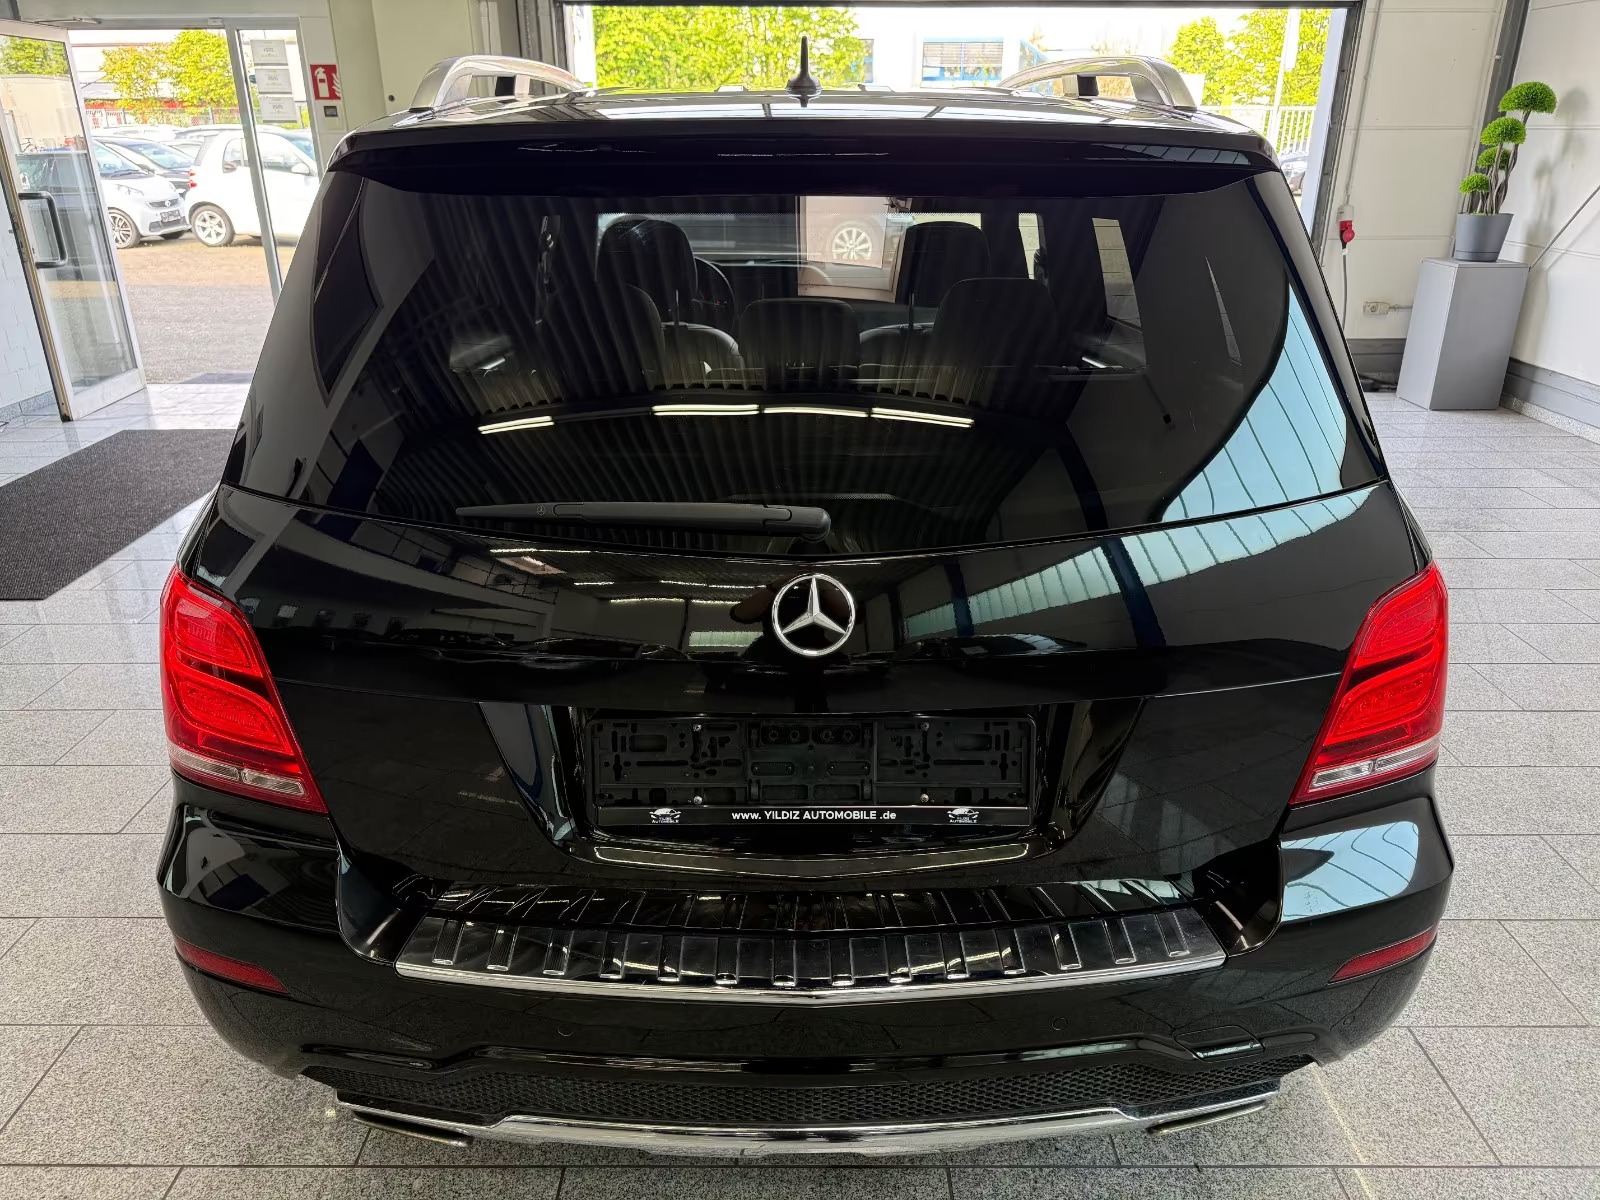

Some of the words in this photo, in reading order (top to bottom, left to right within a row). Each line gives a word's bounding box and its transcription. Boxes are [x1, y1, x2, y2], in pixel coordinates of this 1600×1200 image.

[731, 811, 762, 820] www.
[764, 810, 800, 820] YILDIZ
[802, 810, 877, 820] AUTOMOBILE
[879, 810, 897, 820] .de
